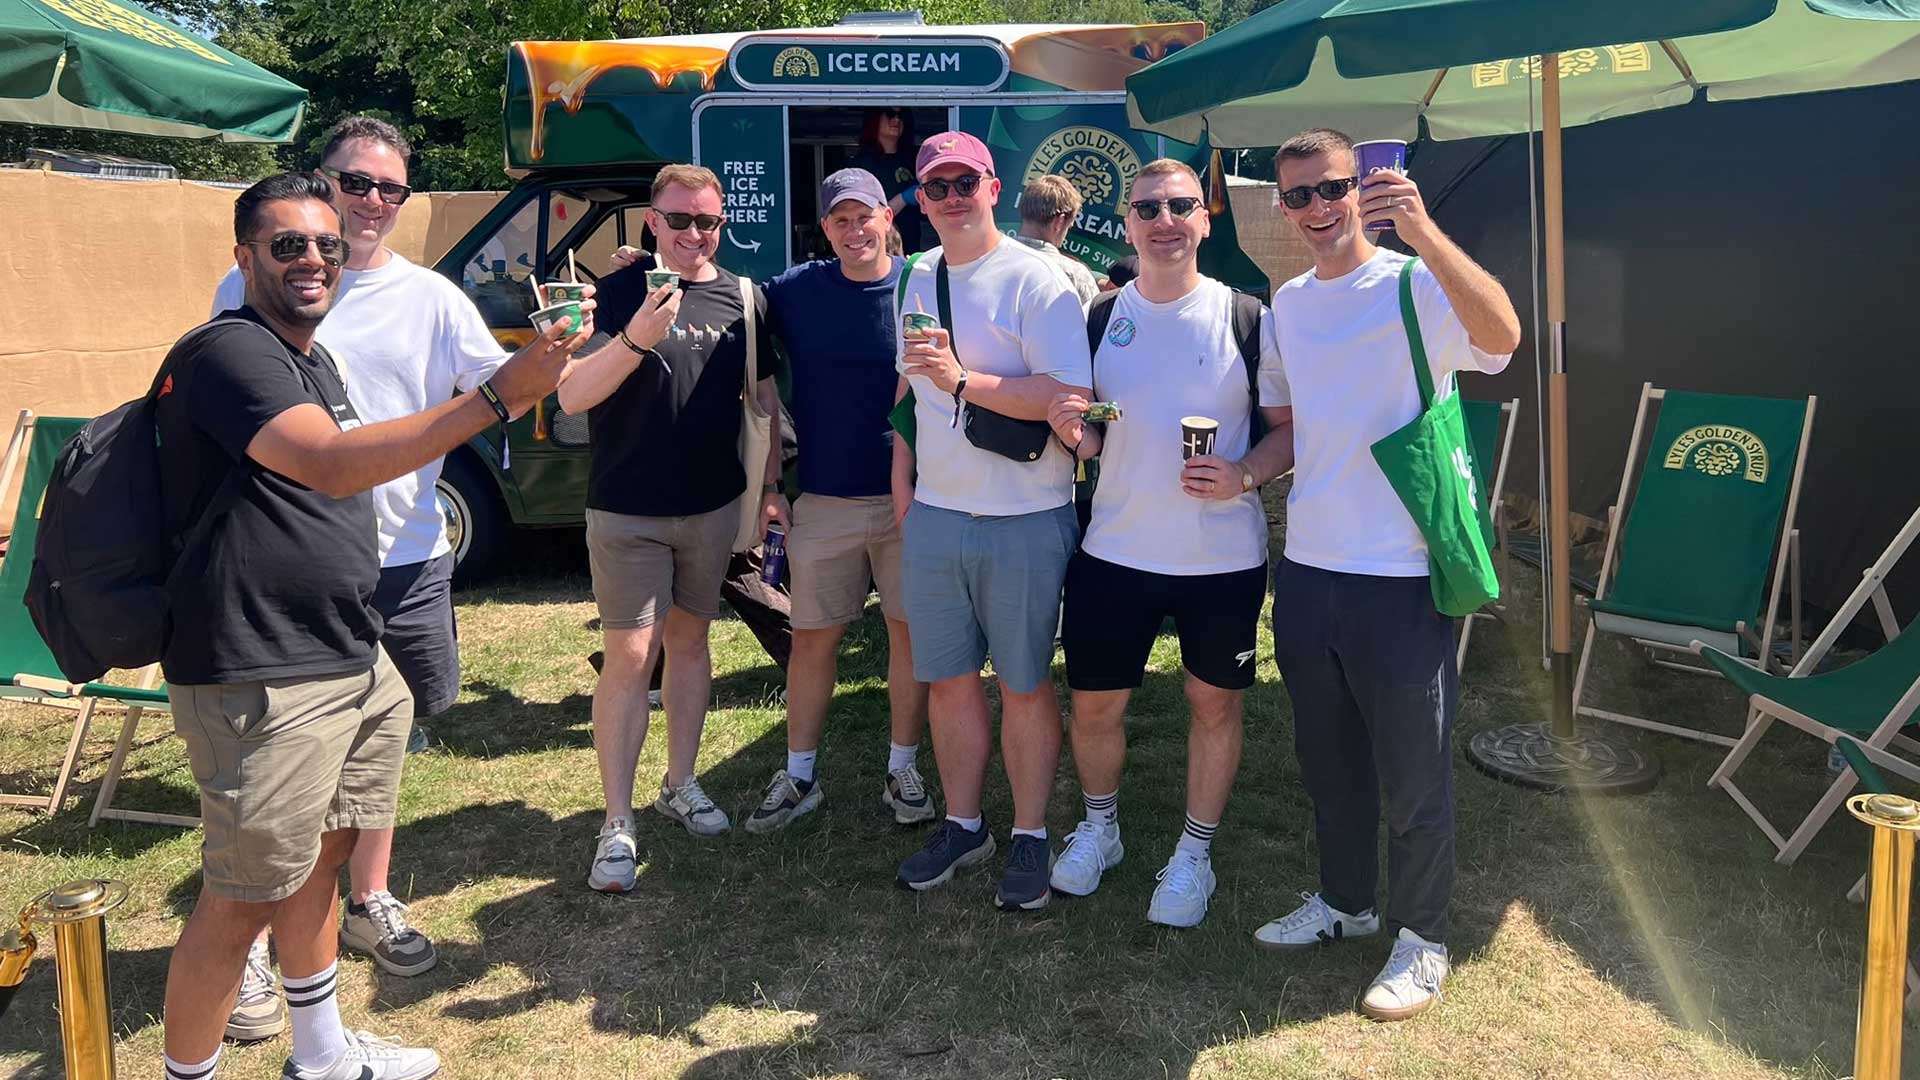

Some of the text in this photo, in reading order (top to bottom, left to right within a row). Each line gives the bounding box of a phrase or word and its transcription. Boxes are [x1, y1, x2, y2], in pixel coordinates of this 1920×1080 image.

[828, 53, 960, 72] ICE CREAM
[1063, 130, 1130, 163] GOLDEN
[723, 161, 765, 175] FREE
[731, 177, 758, 191] ICE
[723, 209, 767, 223] HERE
[1075, 211, 1127, 240] REAM
[1060, 239, 1091, 256] RUP
[1668, 427, 1764, 477] LYLE'S GOLDEN SYRUP
